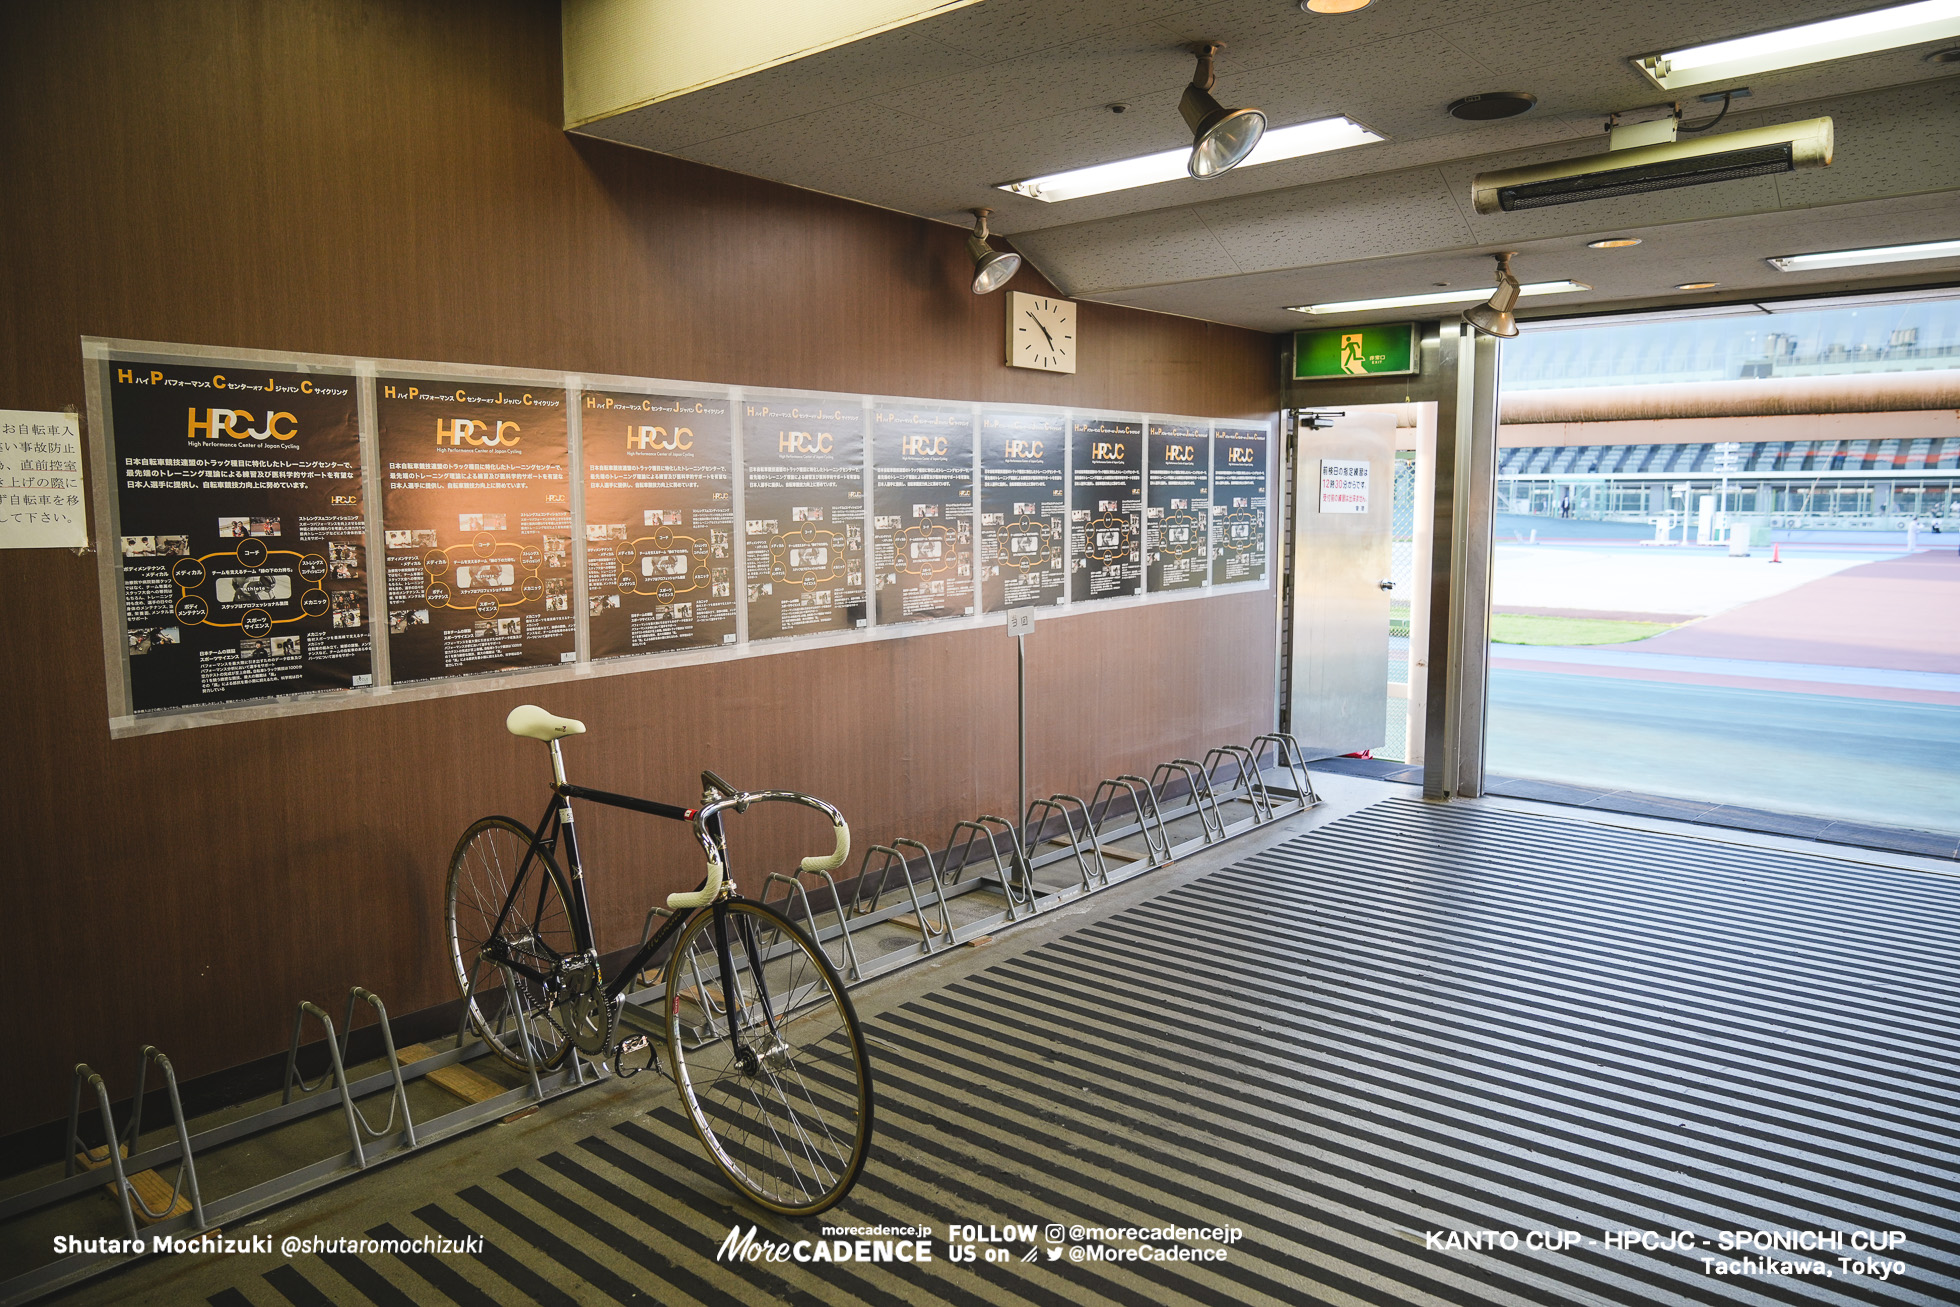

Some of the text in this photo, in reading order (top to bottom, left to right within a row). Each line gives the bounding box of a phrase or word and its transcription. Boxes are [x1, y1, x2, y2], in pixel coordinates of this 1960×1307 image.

[2, 423, 74, 437] お自転車入
[188, 407, 298, 441] HPCJC
[436, 418, 521, 447] HPCJC
[627, 425, 694, 450] HPCJC
[0, 442, 75, 454] い事故防止
[188, 441, 201, 449] High
[202, 441, 236, 449] Performance
[779, 431, 833, 453] HPCJC
[902, 435, 948, 456] HPCJC
[436, 447, 447, 455] High
[303, 599, 327, 607] メカニック
[178, 609, 206, 617] メンテナンス
[244, 623, 270, 631] サイエンス
[246, 617, 267, 625] スポーツ
